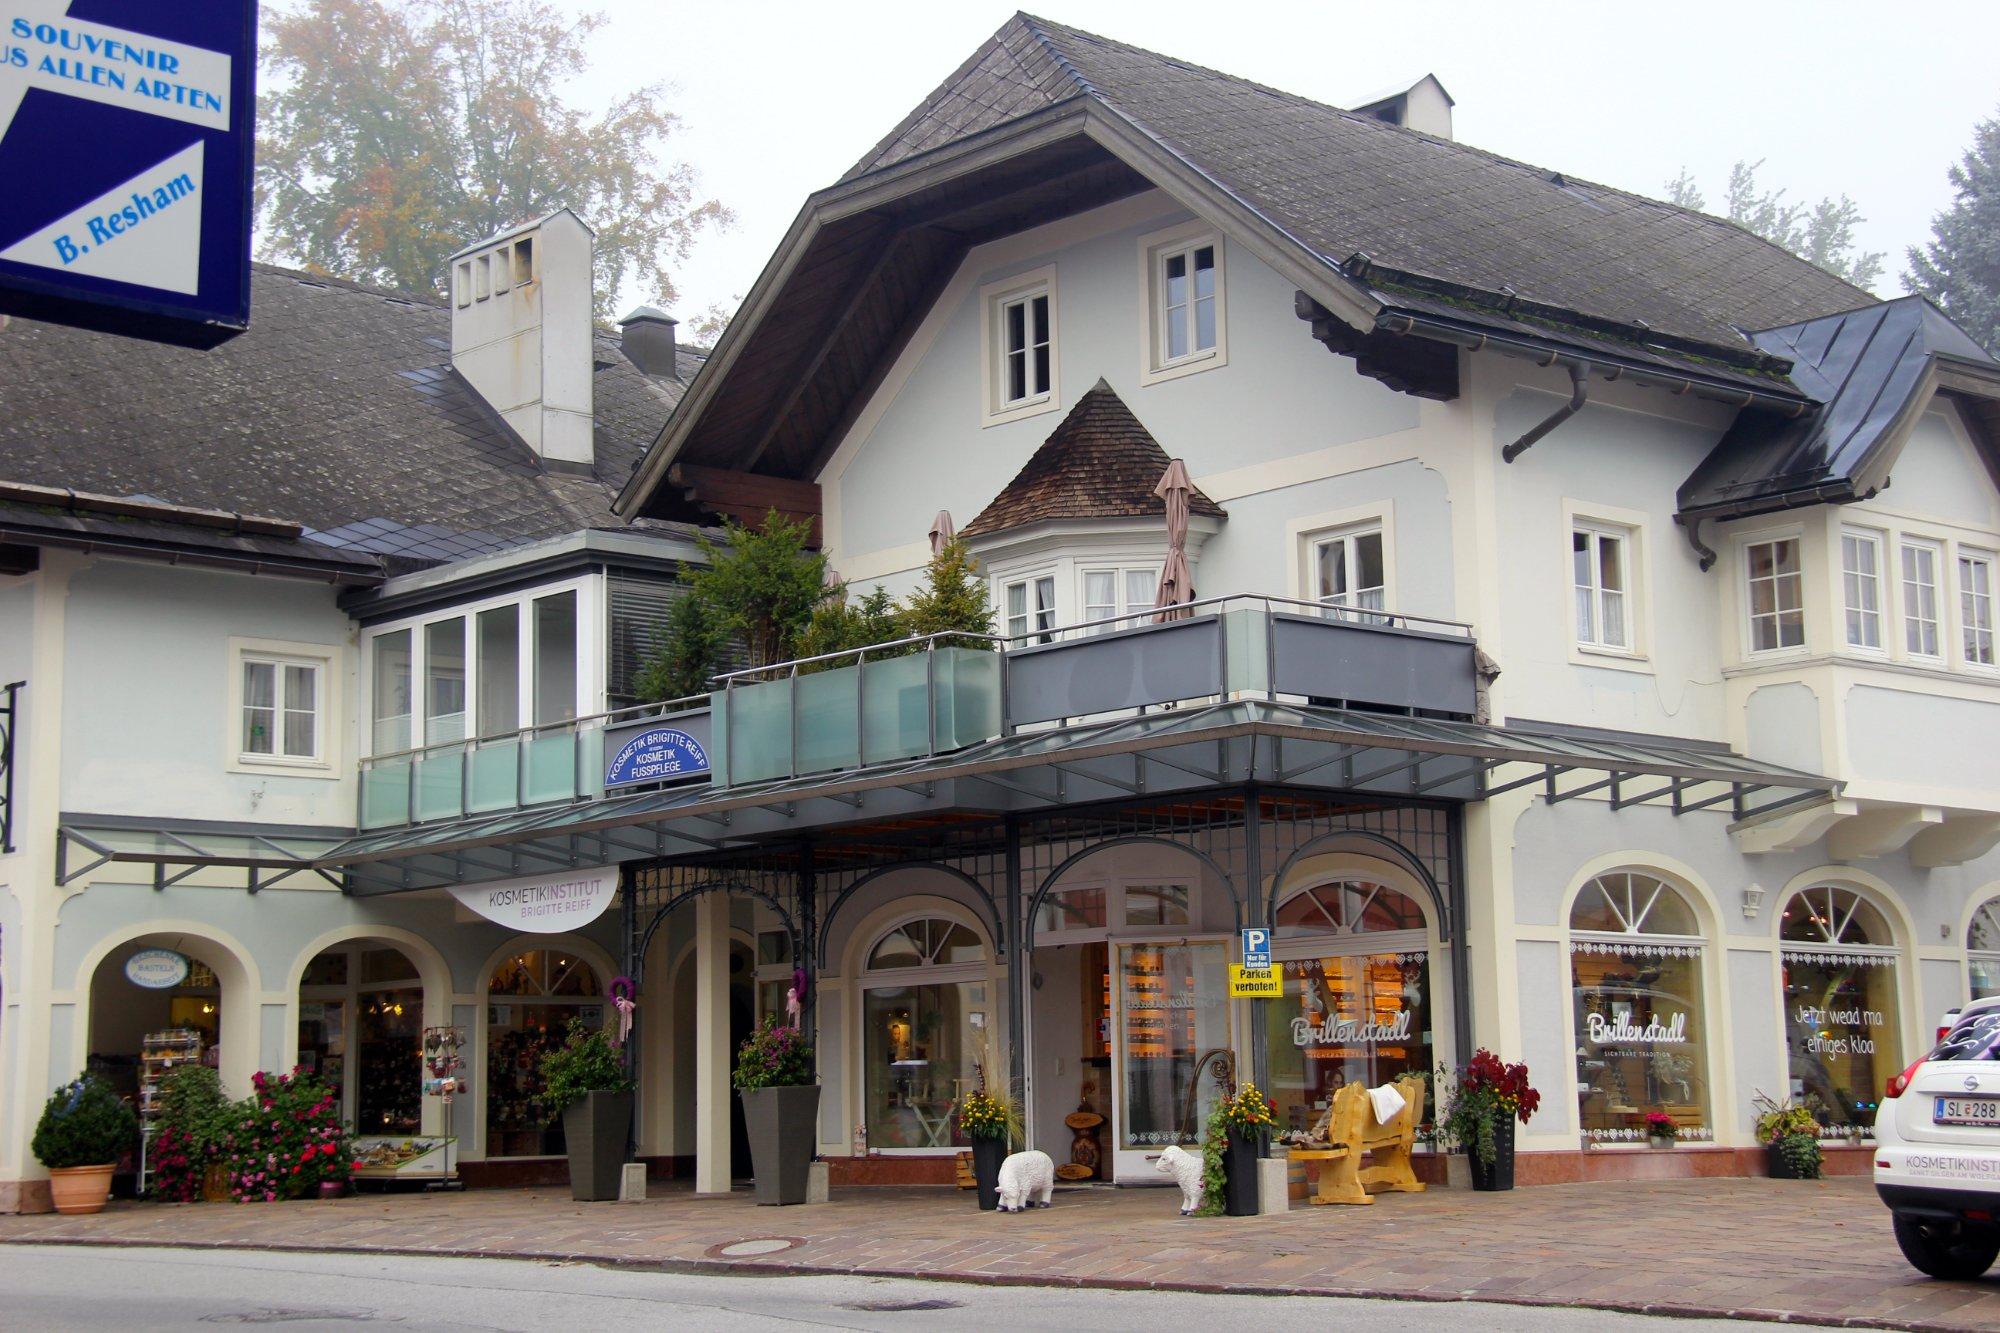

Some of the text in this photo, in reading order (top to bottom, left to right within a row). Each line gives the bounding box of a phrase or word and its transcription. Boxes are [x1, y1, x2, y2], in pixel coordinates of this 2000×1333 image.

[11, 18, 180, 75] SOUVENIR
[38, 54, 125, 91] ALLEN
[133, 76, 222, 114] ARTEN
[53, 172, 196, 266] B. Resham
[610, 732, 706, 780] KOSMETIK BRIGITTE REIFF
[636, 749, 676, 765] KOSMETIK
[631, 760, 681, 778] FUSSPFLEGE
[489, 879, 602, 907] KOSMETIKINSTITUT
[521, 899, 592, 919] BRIGITTE REIFF
[1248, 930, 1265, 952] P
[1240, 969, 1272, 979] Parken
[1235, 981, 1278, 992] verboten!
[1586, 1010, 1686, 1043] Brillenstadl
[1795, 1005, 1883, 1026] Jetzt wead ma
[1291, 1010, 1411, 1046] Brillenstadl
[1807, 1034, 1875, 1061] einiges kloa
[1947, 1101, 1996, 1118] SL 288
